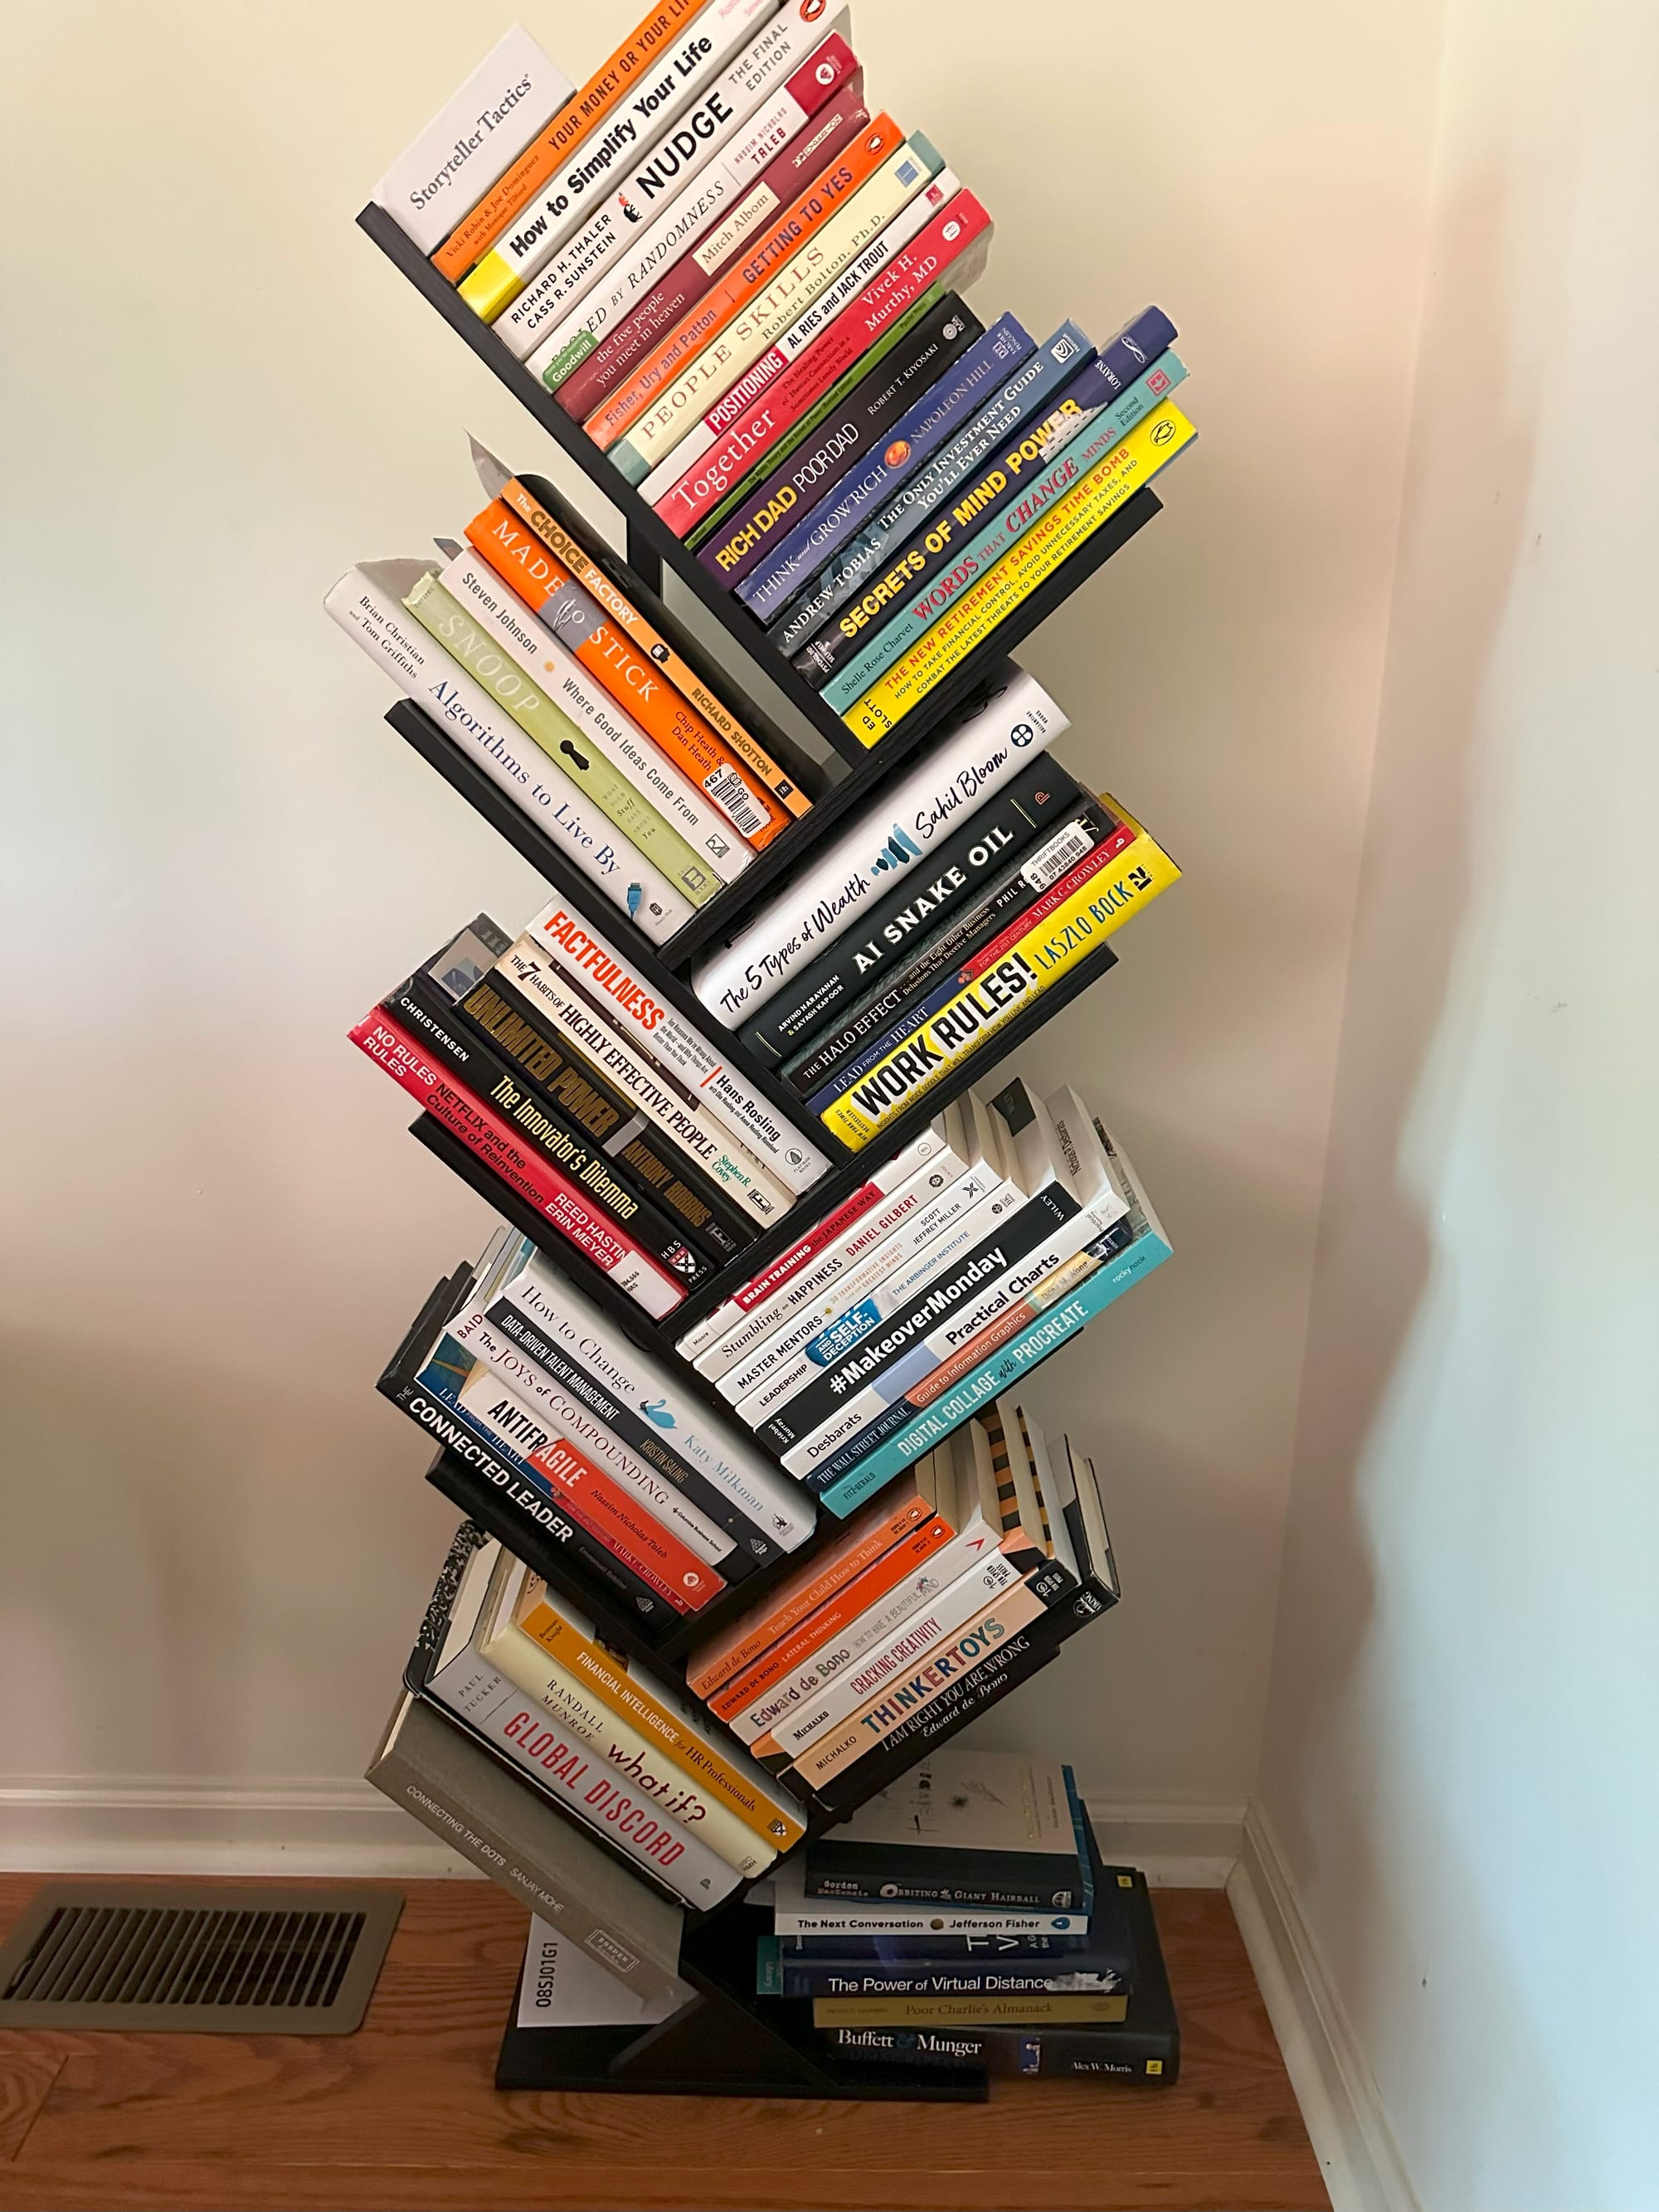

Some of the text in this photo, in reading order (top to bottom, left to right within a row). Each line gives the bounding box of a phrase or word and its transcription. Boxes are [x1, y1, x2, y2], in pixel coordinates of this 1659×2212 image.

[408, 128, 487, 211] Storyteller
[508, 35, 713, 257] How to Simplify Your Life
[635, 90, 734, 199] NUDGE
[510, 213, 611, 323] RICHARD H. THALER
[701, 193, 769, 264] Mitch Albom
[741, 166, 854, 284] GETTING TO YES
[527, 231, 616, 328] CASS R. SUNSTEIN
[786, 240, 889, 349] AL RIES and JACK TROUT
[551, 338, 592, 382] Goodwill
[640, 246, 825, 440] PEOPLE SKILLS
[707, 351, 785, 430] POSITIONING
[669, 406, 780, 513] Together
[714, 422, 859, 571] RICH DAD POOR DAD
[515, 493, 638, 625] The CHOICE FACTORY
[752, 464, 888, 604] THINK and GROW RICH
[838, 469, 1009, 638] SECRETS OF MIND
[884, 447, 1131, 690] THE NEW RETIREMENT SAVINGS TIME BOMB
[911, 427, 1117, 622] WORDS THAT CHANGE MINDS
[461, 572, 538, 654] Steven Johnson
[491, 519, 659, 702] MADE to STICK
[781, 537, 884, 643] ANDREW TOBIAS
[840, 622, 914, 694] Shelle Rose Charvet
[561, 677, 699, 826] Where Good Ideas Come From
[861, 714, 877, 731] ED
[864, 697, 893, 728] SLOTT
[426, 678, 622, 878] Algorithms to Live By
[912, 745, 1011, 839] Sahil Bloom
[1030, 831, 1070, 866] THRIFTBOOKS
[718, 872, 872, 1014] The 5 Types of Wealth
[852, 824, 1014, 973] AI SNAKE OIL
[1034, 880, 1134, 970] LASZLO BOCK
[543, 909, 664, 1032] FACTFULNESS
[363, 1036, 406, 1077] RULES
[372, 1026, 436, 1086] NO RULES
[399, 996, 469, 1062] CHRISTENSEN
[461, 983, 620, 1138] UNLIMITED POWER
[850, 951, 1038, 1118] WORK RULES!
[557, 1003, 718, 1160] HIGHLY EFFECTIVE PEOPLE
[715, 1074, 781, 1142] Hans Rosling
[489, 1075, 522, 1110] The
[578, 1160, 639, 1220] Dilemma
[1039, 1194, 1065, 1221] WILEY
[520, 1285, 637, 1394] How to Change
[827, 1246, 1008, 1395] #MakeoverMonday
[945, 1252, 1059, 1345] Practical Charts
[500, 1314, 620, 1422] DATA-DRIVEN TALENT MANAGEMENT
[736, 1315, 824, 1389] MASTER MENTORS
[758, 1364, 808, 1407] LEADERSHIP
[897, 1300, 1089, 1456] DIGITAL COLLAGE with PROCREATE
[478, 1331, 669, 1505] The JOYS of COMPOUNDING
[487, 1398, 588, 1489] ANTIFRAGILE
[806, 1412, 862, 1458] Desbarats
[408, 1396, 573, 1544] CONNECTED LEADER
[576, 1651, 679, 1743] FINANCIAL INTELLIGENCE
[849, 1616, 943, 1695] CRACKING CREATIVITY
[859, 1616, 1007, 1735] THINKERTOYS
[792, 1710, 830, 1740] MICHALKO
[815, 1735, 857, 1770] MICHALKO
[406, 1784, 506, 1867] CONNECTING THE DOTS
[503, 1710, 686, 1868] GLOBAL DISCORD
[606, 1739, 708, 1826] what if?
[796, 1918, 924, 1928] The Next Conversation
[948, 1918, 1040, 1929] Jefferson Fisher
[826, 1975, 1054, 1992] The Power of Virtual Distance
[837, 2028, 983, 2058] Buffett Munger
[1073, 2061, 1090, 2071] Alex
[1103, 2062, 1133, 2073] Morris
